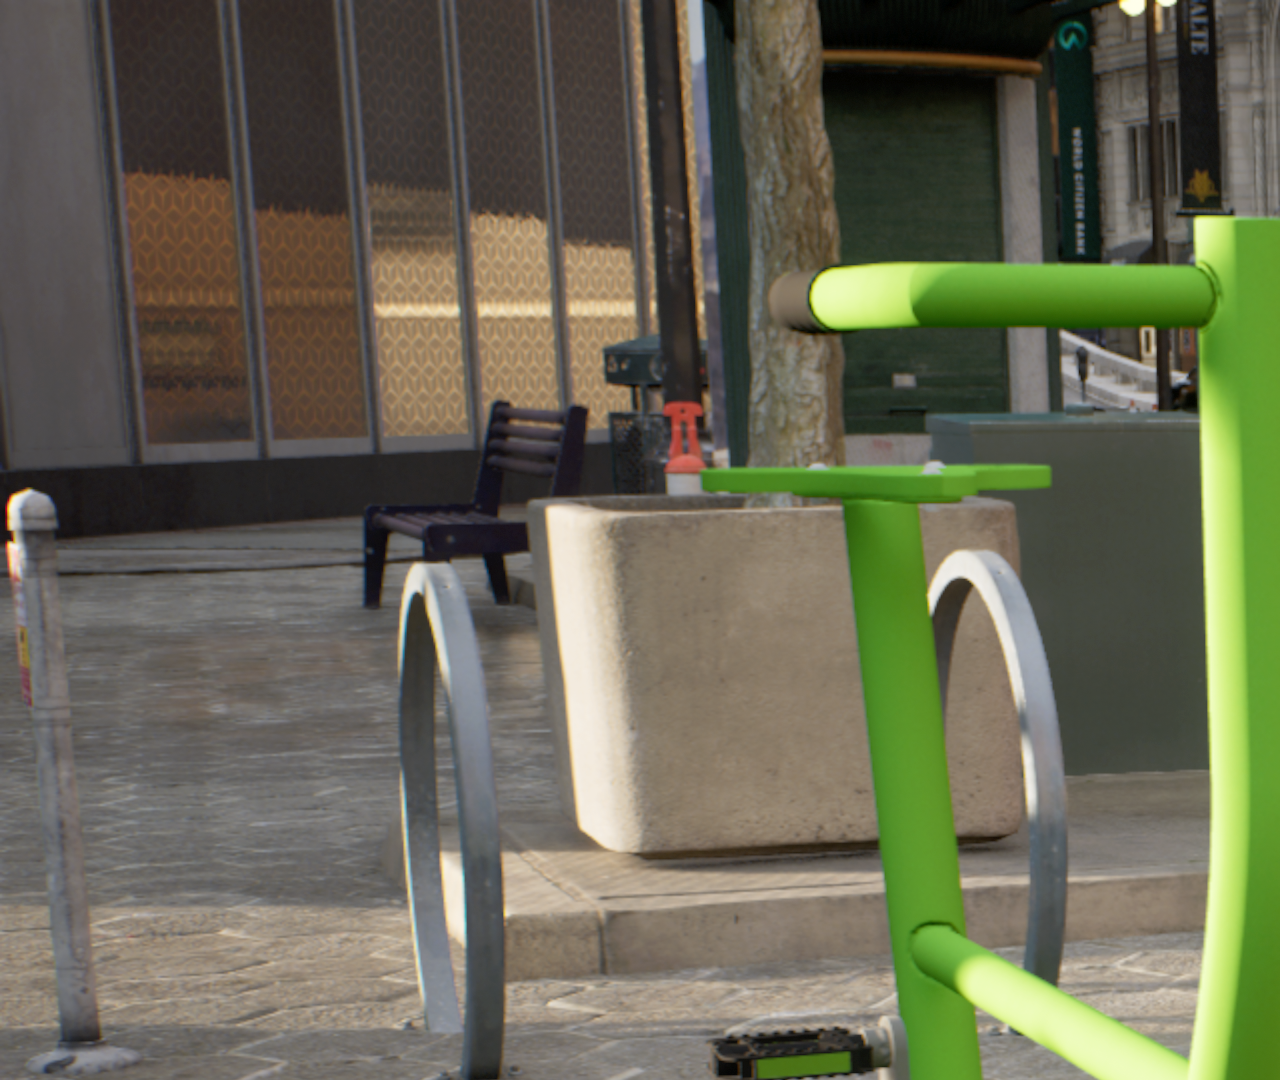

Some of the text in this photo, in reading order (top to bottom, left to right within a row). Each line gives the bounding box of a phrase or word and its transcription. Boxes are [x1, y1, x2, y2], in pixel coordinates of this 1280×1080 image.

[1189, 0, 1209, 55] ALTE
[1071, 127, 1086, 255] WORLD CITIZEN BANK
